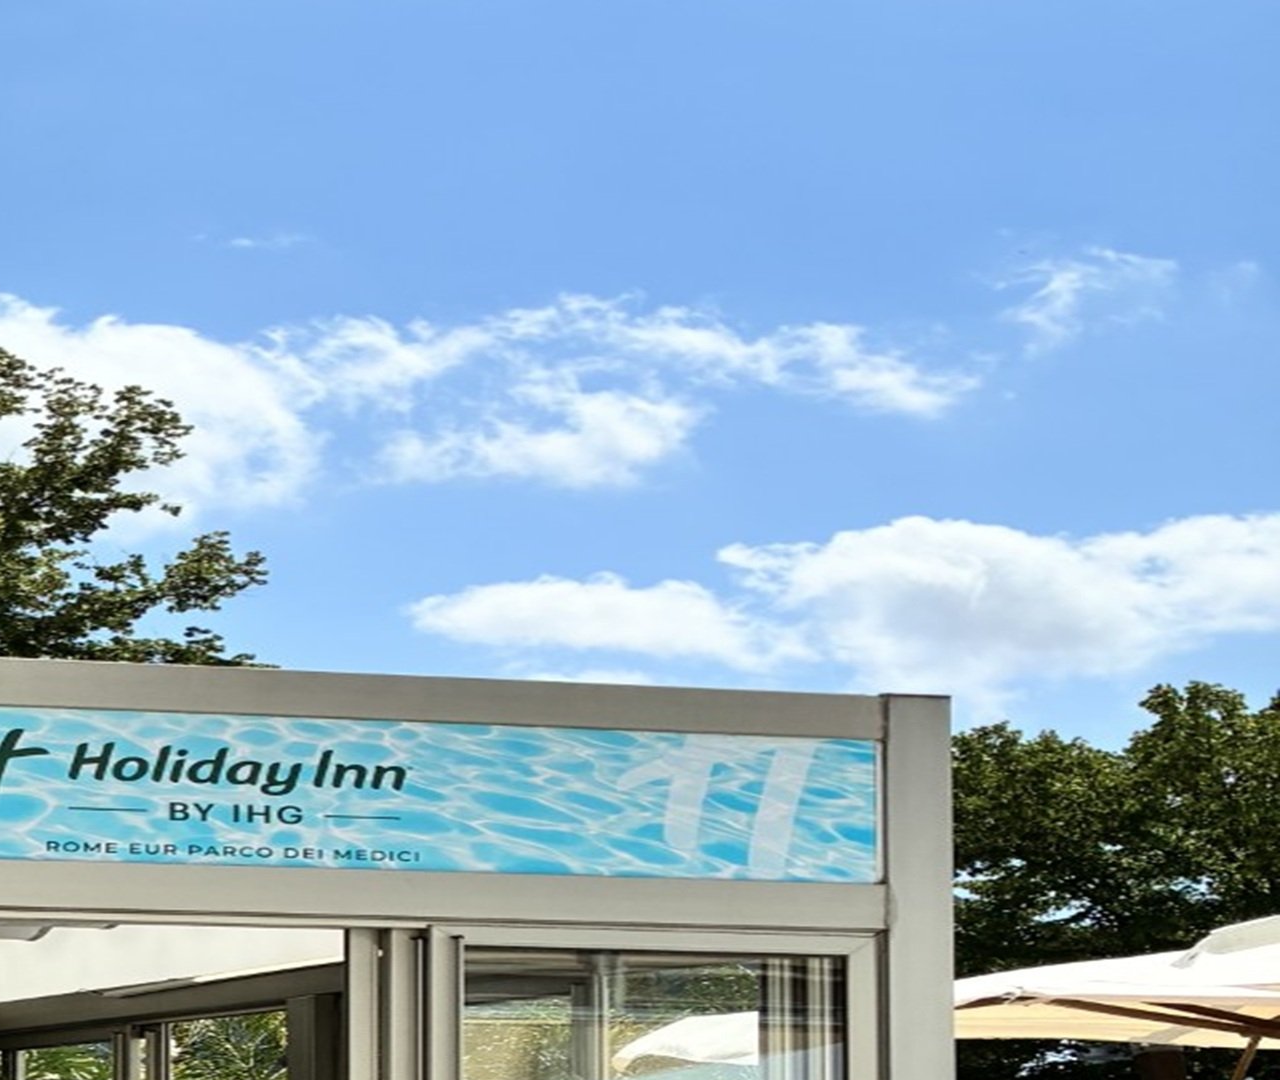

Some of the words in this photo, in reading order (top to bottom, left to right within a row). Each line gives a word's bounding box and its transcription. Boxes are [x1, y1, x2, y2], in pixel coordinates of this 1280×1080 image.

[68, 742, 302, 796] Holiday
[313, 749, 406, 791] Inn
[168, 802, 214, 822] BY
[233, 804, 304, 825] IHG
[45, 840, 118, 855] ROME
[128, 843, 178, 857] EUR
[188, 844, 274, 859] PARCO
[283, 847, 324, 860] DEI
[333, 849, 420, 863] MEDICI
